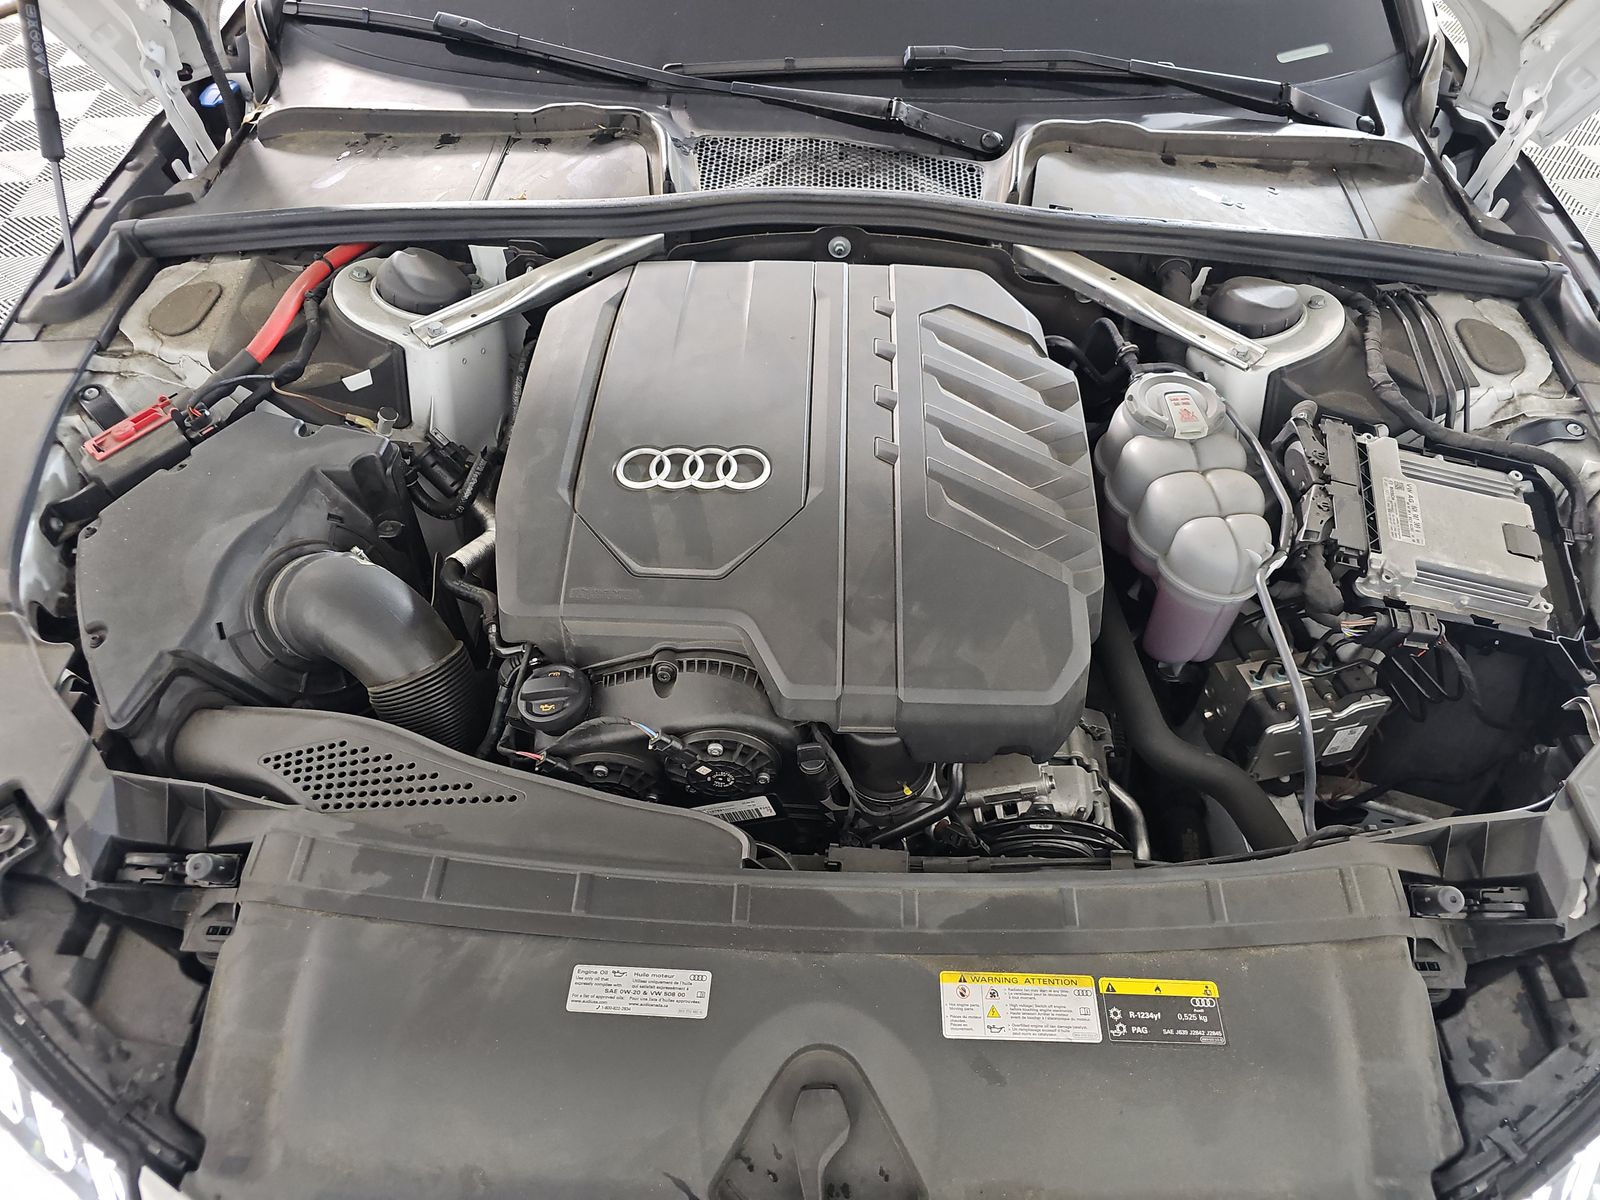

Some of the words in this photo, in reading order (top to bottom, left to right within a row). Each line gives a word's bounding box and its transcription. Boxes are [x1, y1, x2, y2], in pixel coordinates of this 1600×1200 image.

[970, 976, 1019, 984] WARNING
[1024, 978, 1078, 986] ATTENTION
[1129, 1011, 1161, 1021] R-1234yf
[1199, 1014, 1208, 1022] kg
